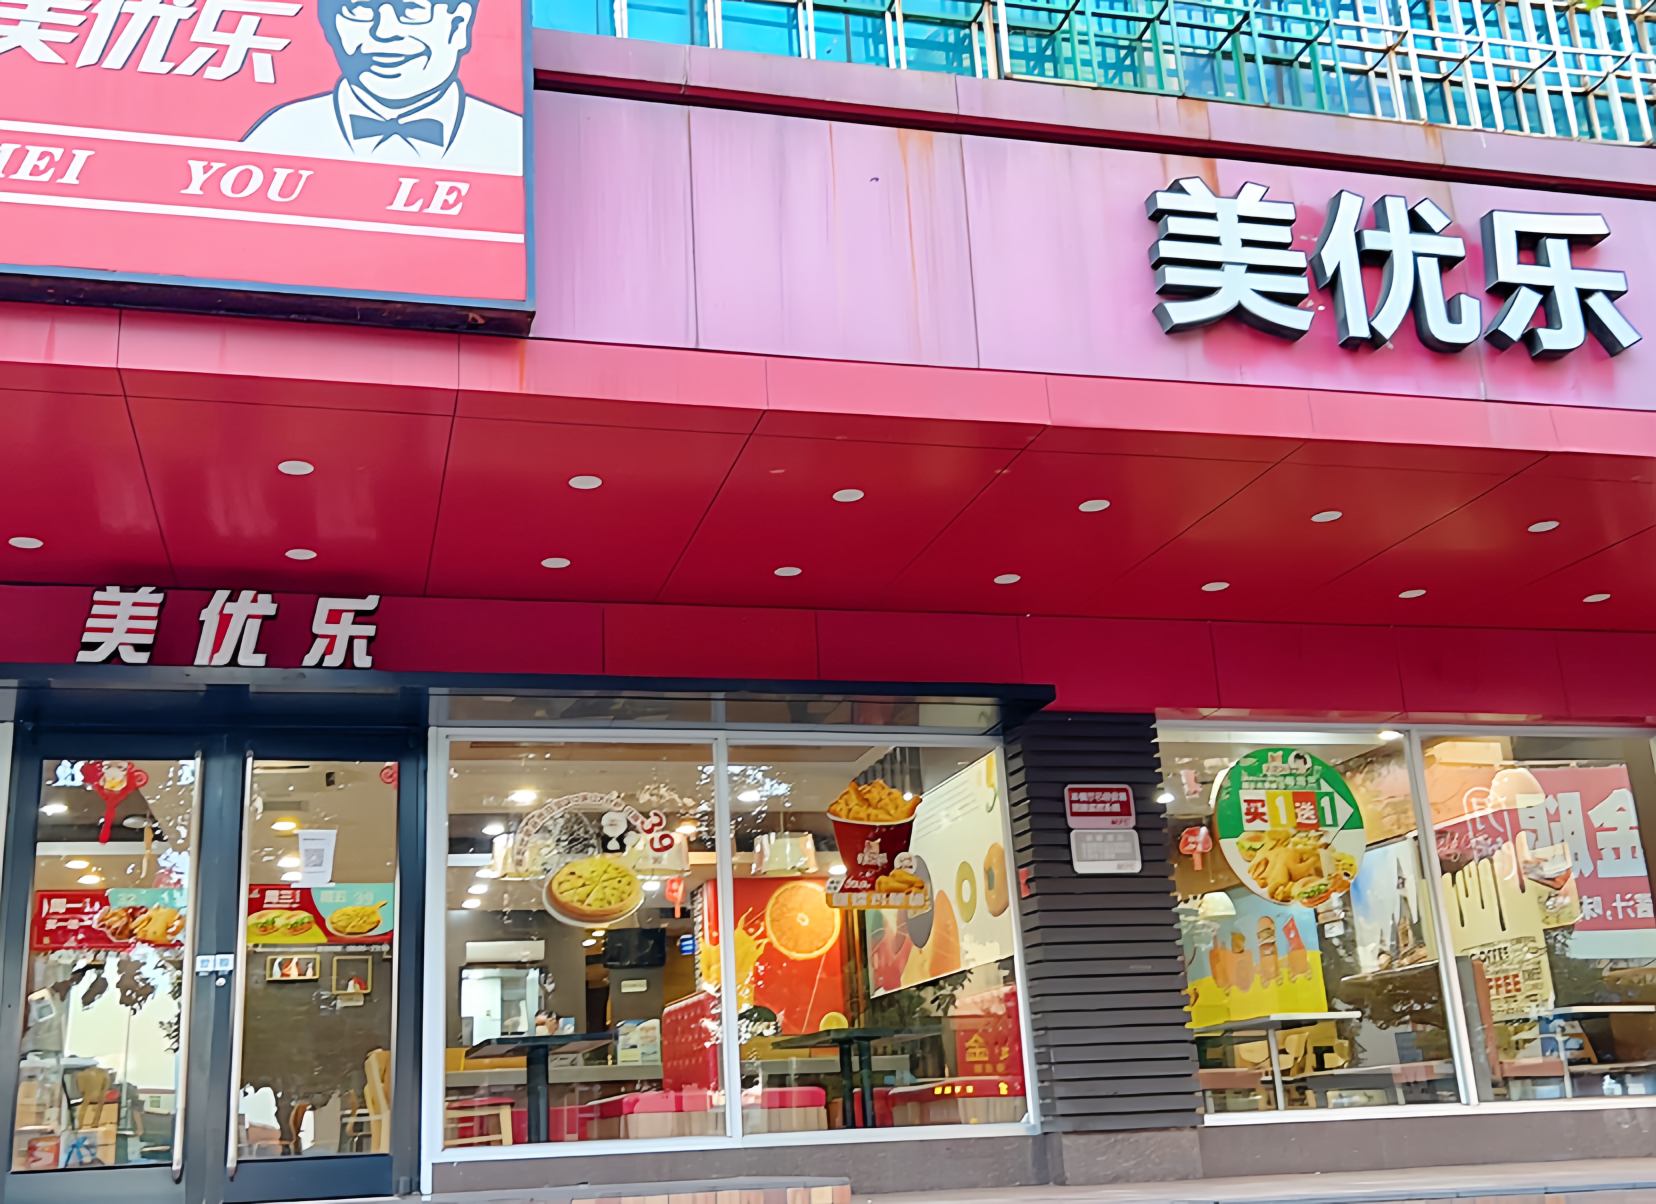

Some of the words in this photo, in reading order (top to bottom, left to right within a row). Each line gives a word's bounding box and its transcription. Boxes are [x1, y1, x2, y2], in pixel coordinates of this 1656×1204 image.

[180, 159, 314, 202] YOU
[385, 177, 470, 215] LE
[1145, 176, 1642, 361] 美优乐
[76, 586, 380, 668] 美优乐
[1243, 795, 1334, 828] 买1送1
